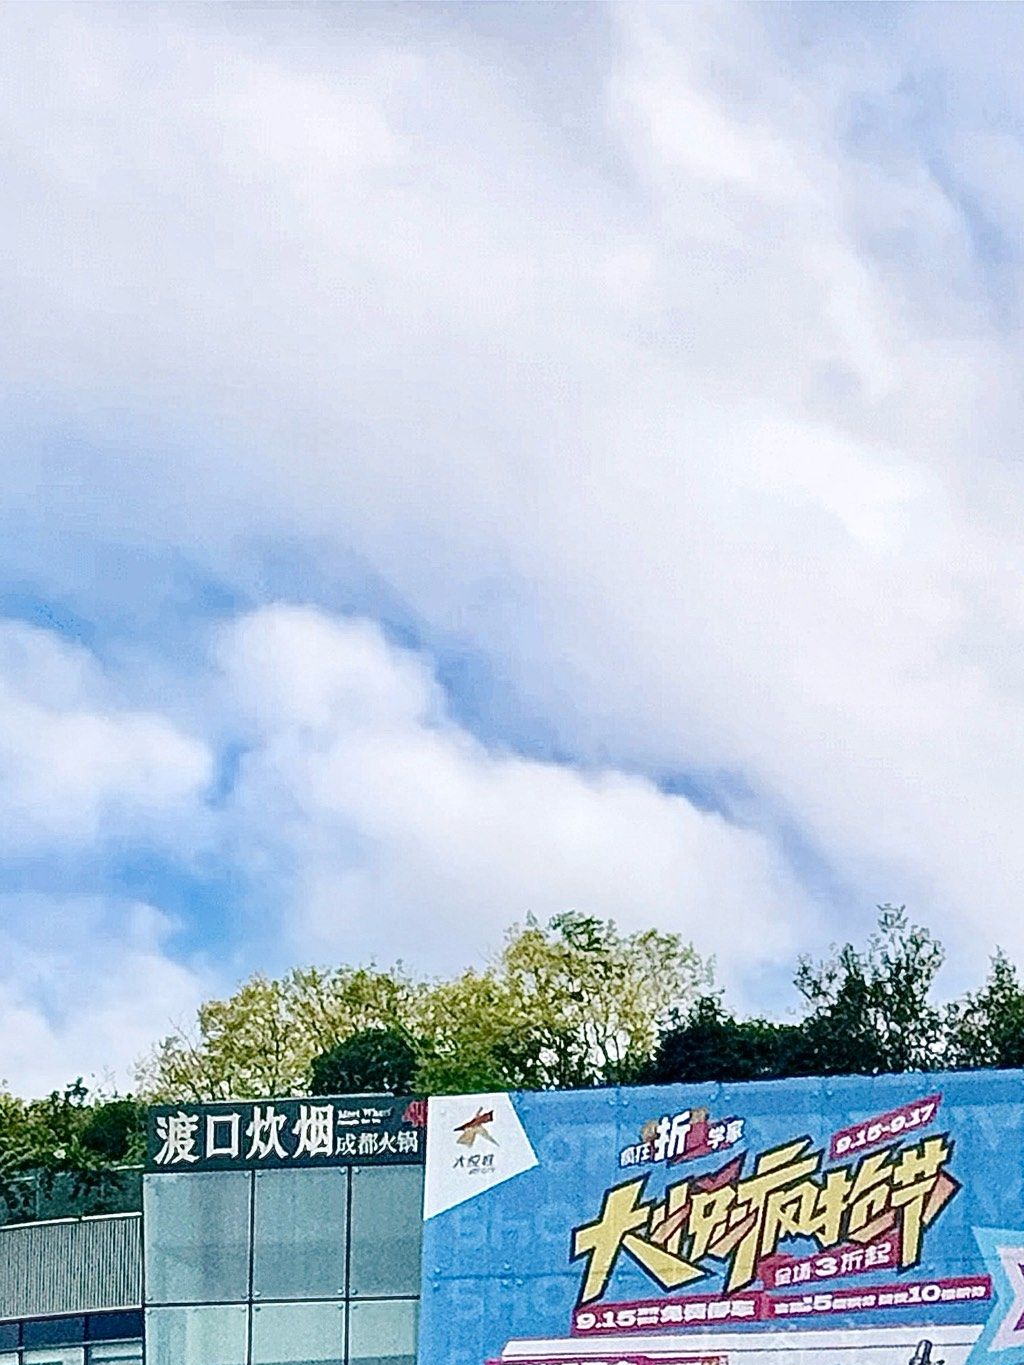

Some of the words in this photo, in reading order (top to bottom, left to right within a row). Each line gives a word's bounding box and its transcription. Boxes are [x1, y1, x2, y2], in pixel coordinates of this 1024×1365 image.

[153, 1104, 334, 1164] 渡口炊烟
[335, 1131, 419, 1156] 成都火锅
